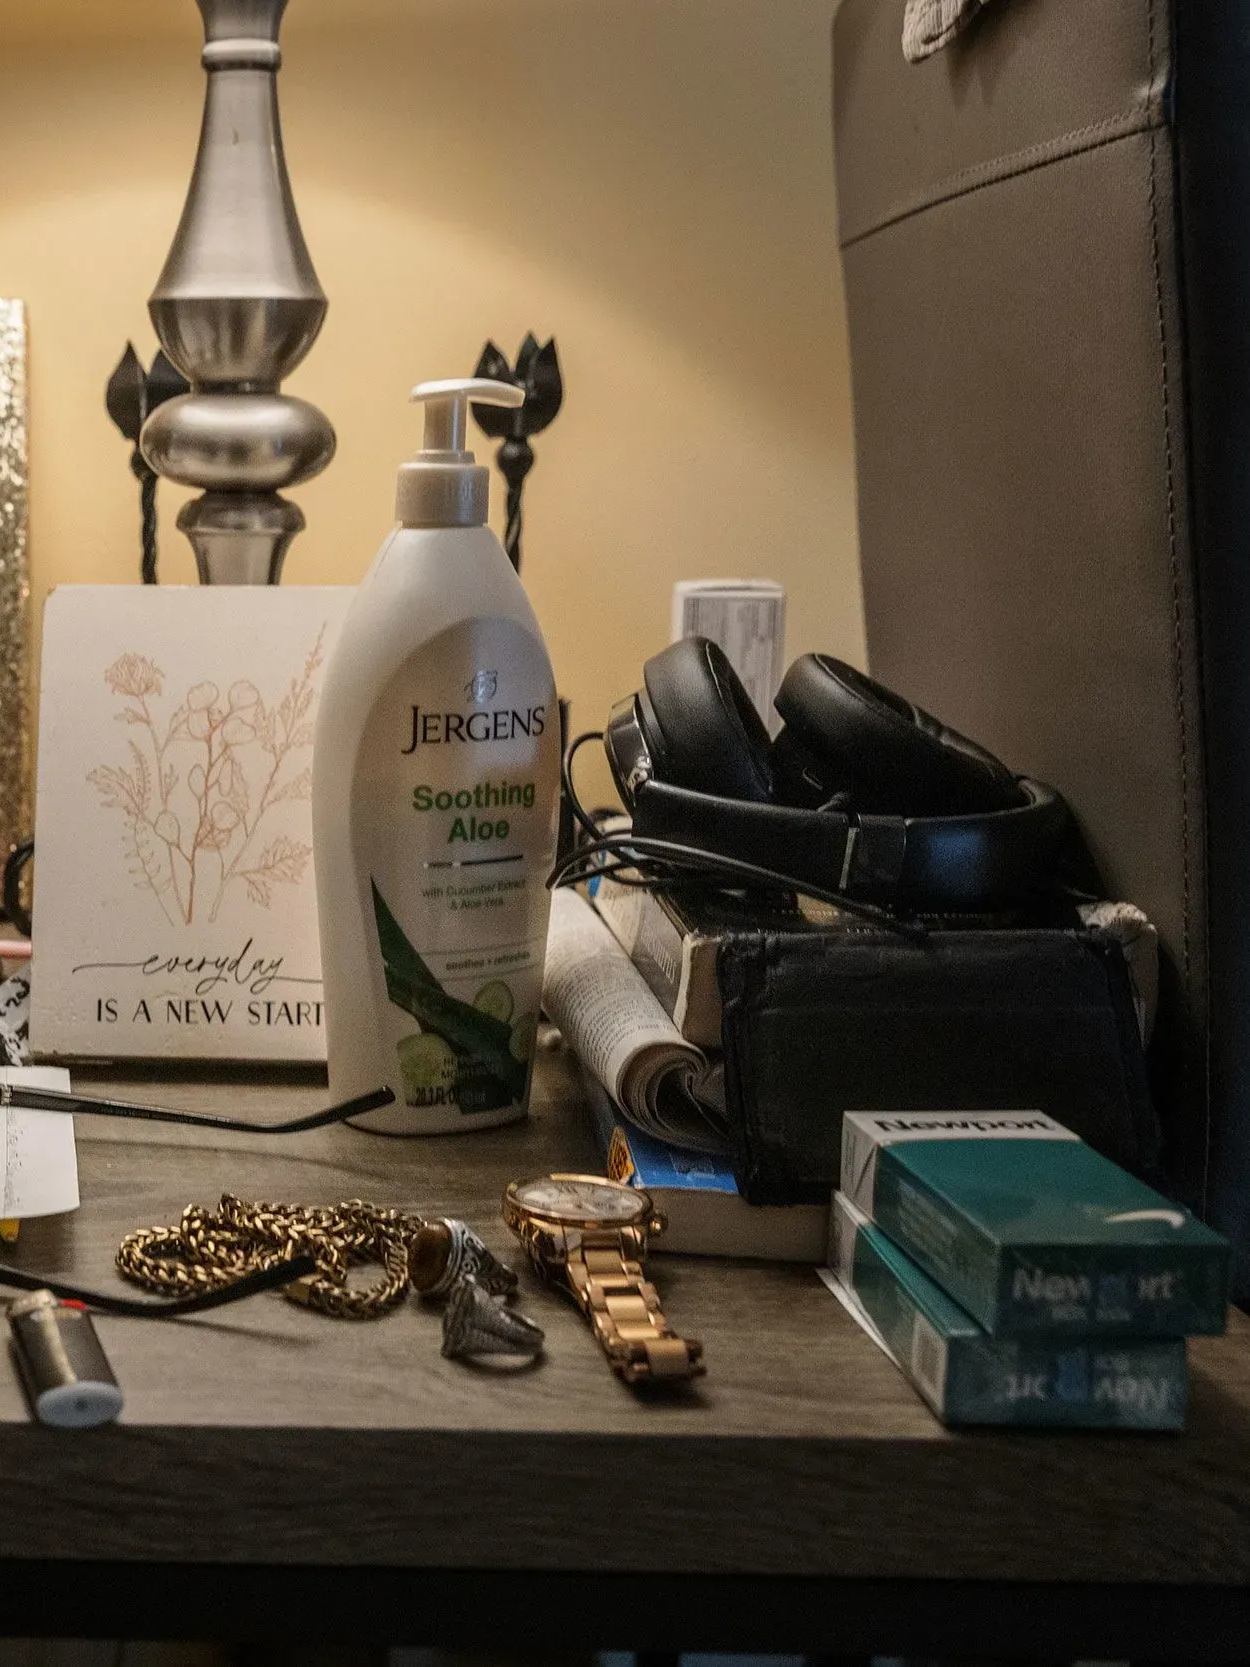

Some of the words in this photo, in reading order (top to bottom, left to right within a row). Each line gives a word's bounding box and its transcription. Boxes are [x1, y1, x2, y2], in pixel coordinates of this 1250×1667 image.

[402, 705, 546, 755] JERGENS
[412, 780, 537, 813] Soothing
[447, 817, 511, 844] Aloe
[141, 938, 286, 994] everyday
[96, 998, 119, 1025] IS
[131, 998, 152, 1025] A
[166, 999, 233, 1026] NEW
[246, 1000, 325, 1027] START
[874, 1117, 1052, 1134] Newport
[1012, 1267, 1174, 1302] Newrt
